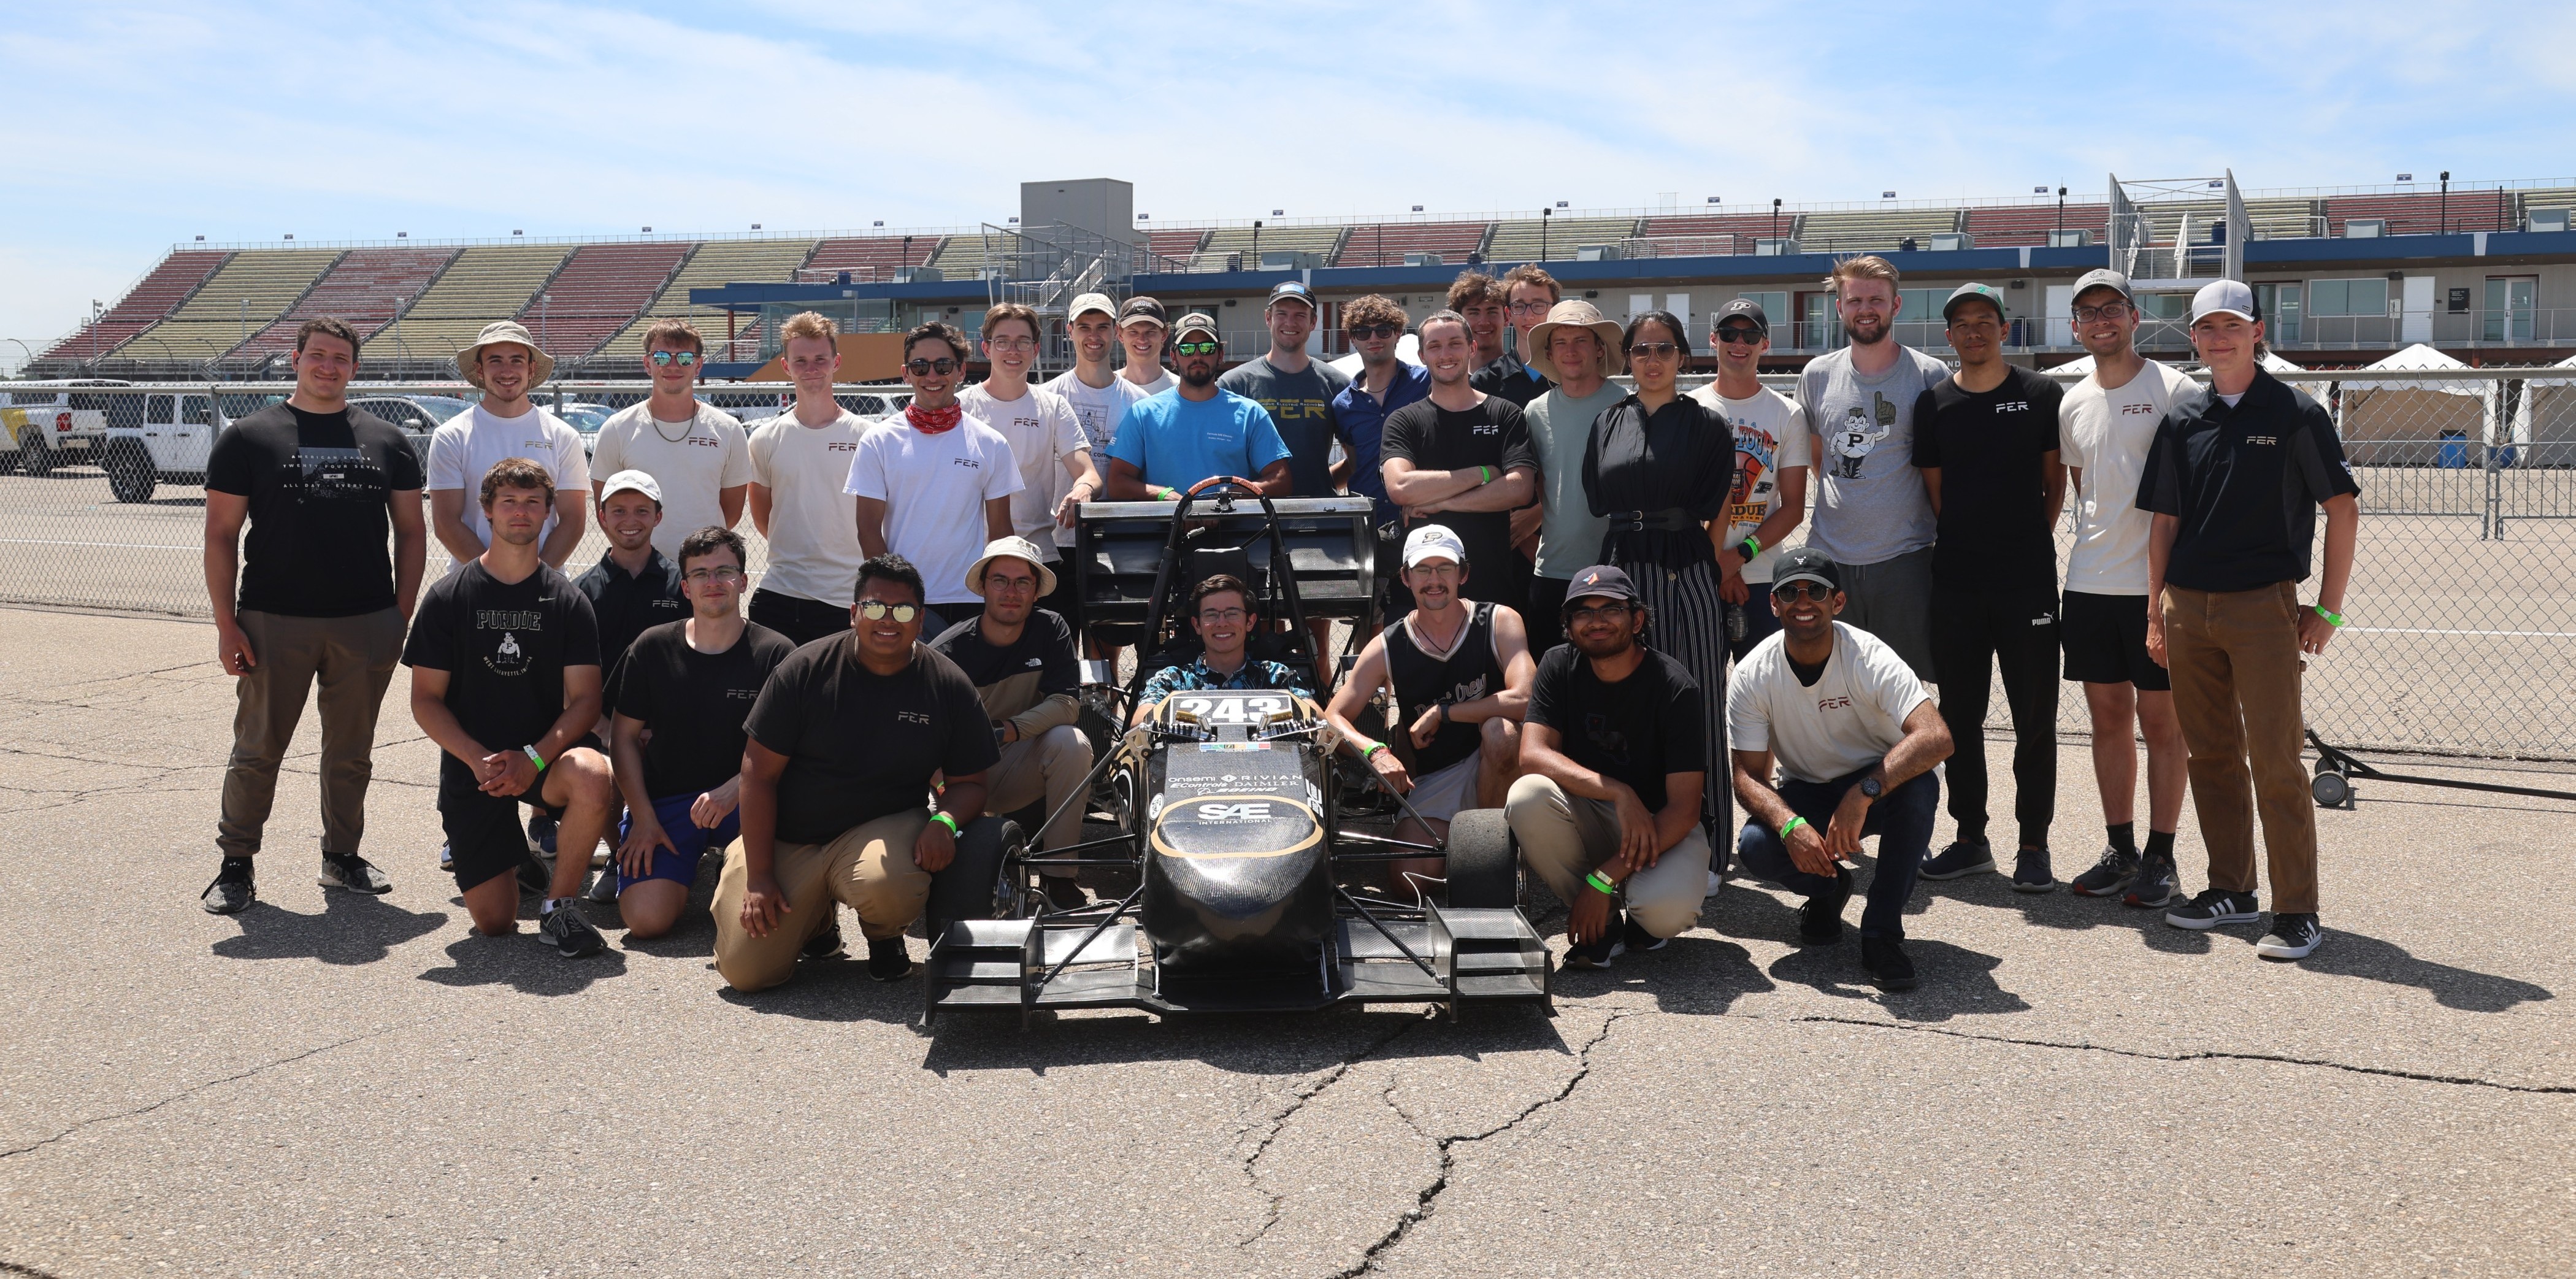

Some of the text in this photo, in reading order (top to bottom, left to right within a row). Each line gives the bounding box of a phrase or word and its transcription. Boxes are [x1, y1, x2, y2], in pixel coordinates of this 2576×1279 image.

[1730, 302, 1751, 311] P
[1847, 433, 1863, 447] P
[1738, 424, 1774, 473] FOUR
[1422, 532, 1443, 543] P
[477, 610, 542, 631] PURDUE
[2032, 617, 2051, 626] PUMA
[483, 656, 495, 669] WEST
[1455, 674, 1487, 703] Crew
[1179, 698, 1282, 723] 243
[1198, 803, 1271, 820] SAE
